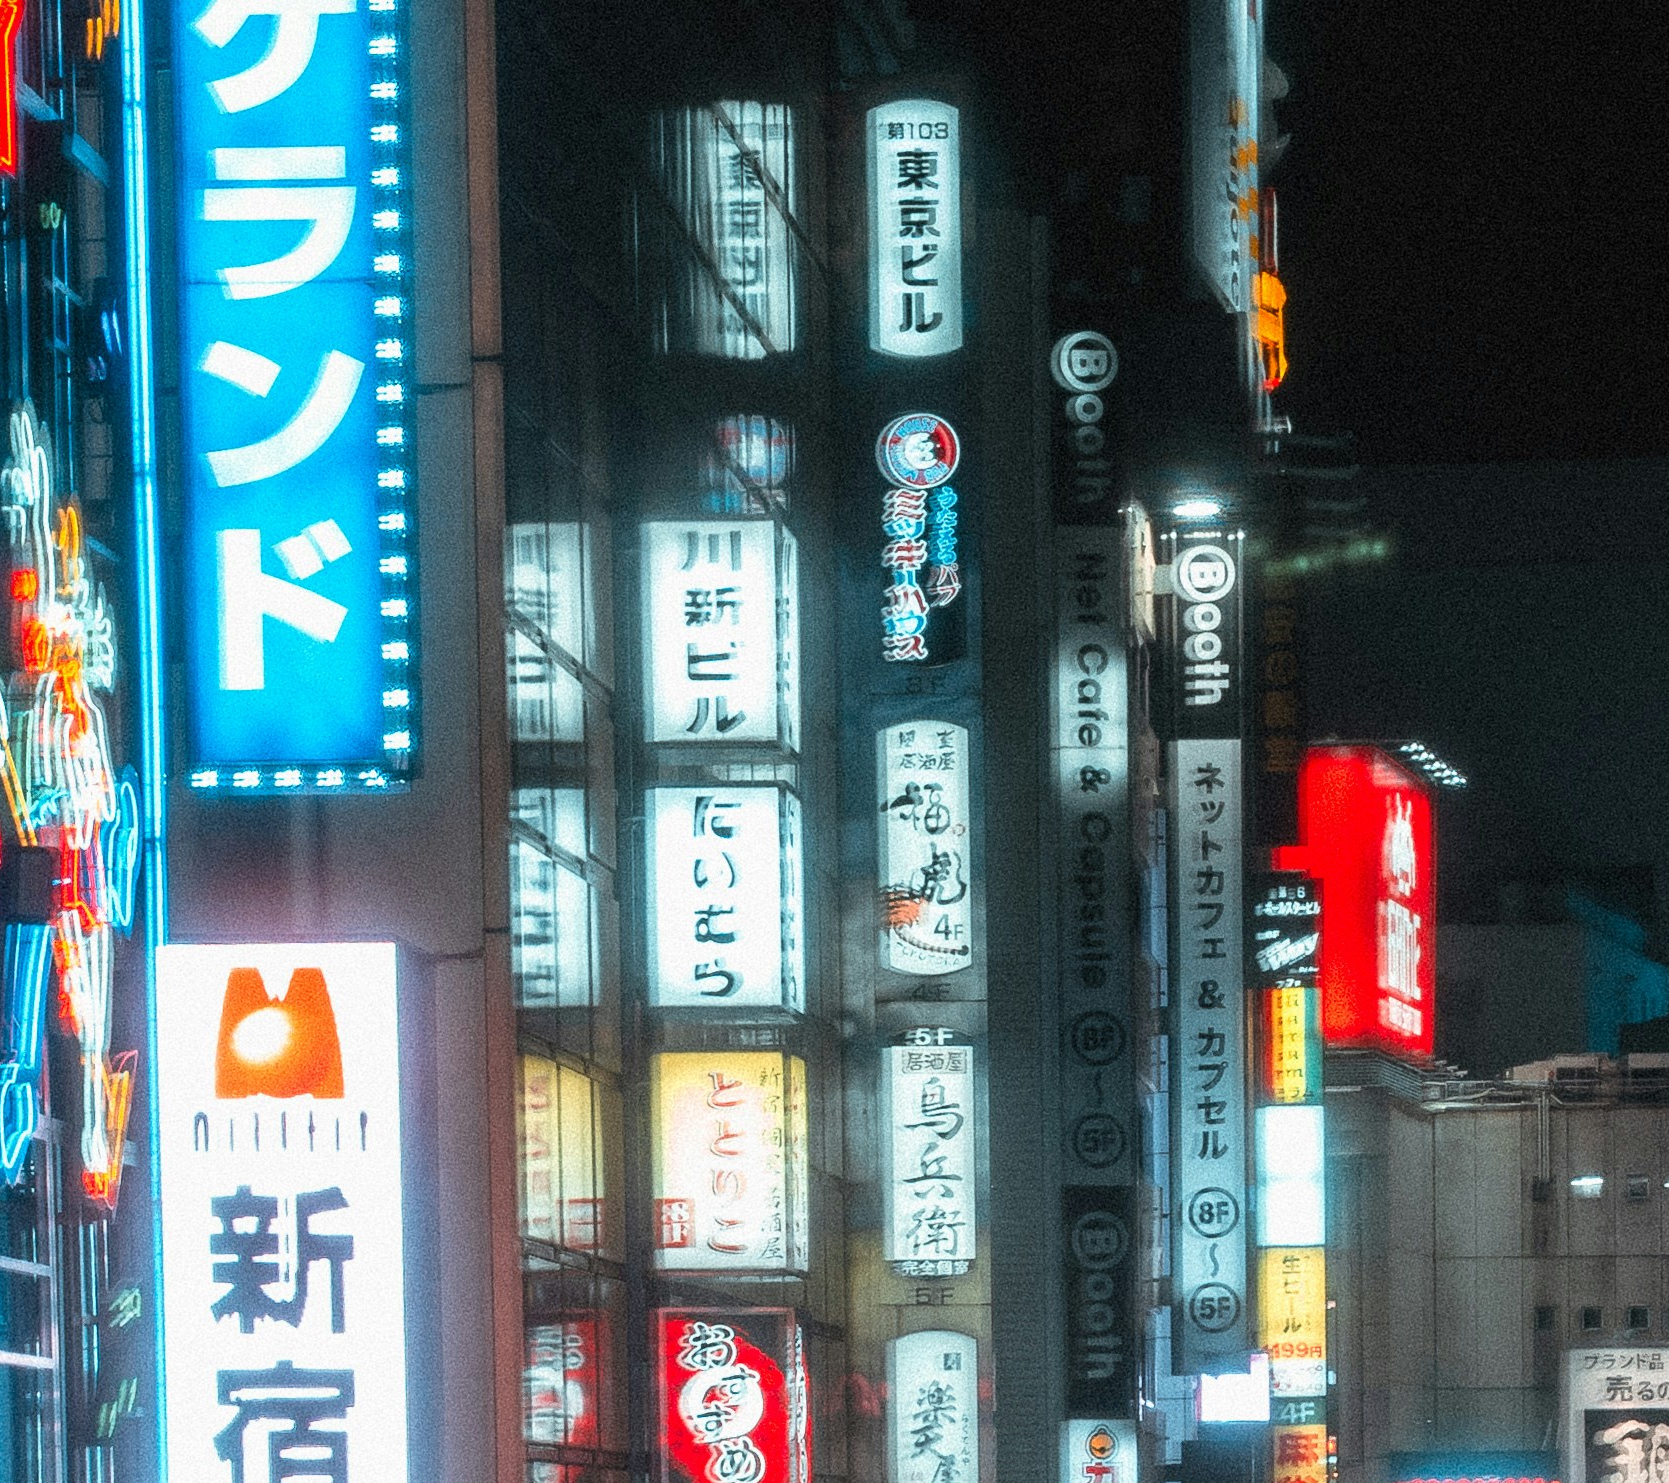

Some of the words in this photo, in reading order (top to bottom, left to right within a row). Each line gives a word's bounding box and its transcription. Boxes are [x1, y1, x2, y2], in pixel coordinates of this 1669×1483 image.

[887, 121, 950, 141] 第103
[896, 147, 944, 334] 東京ビル
[1177, 544, 1237, 706] Booth
[1076, 642, 1110, 747] Cafe
[1193, 761, 1228, 960] ネットカフェ
[933, 912, 965, 940] 4F
[1197, 980, 1226, 1009] &
[1197, 1026, 1229, 1162] カプセル
[1198, 1201, 1230, 1225] 8F
[1199, 1295, 1231, 1319] 5F
[1583, 1353, 1664, 1371] ブランド品
